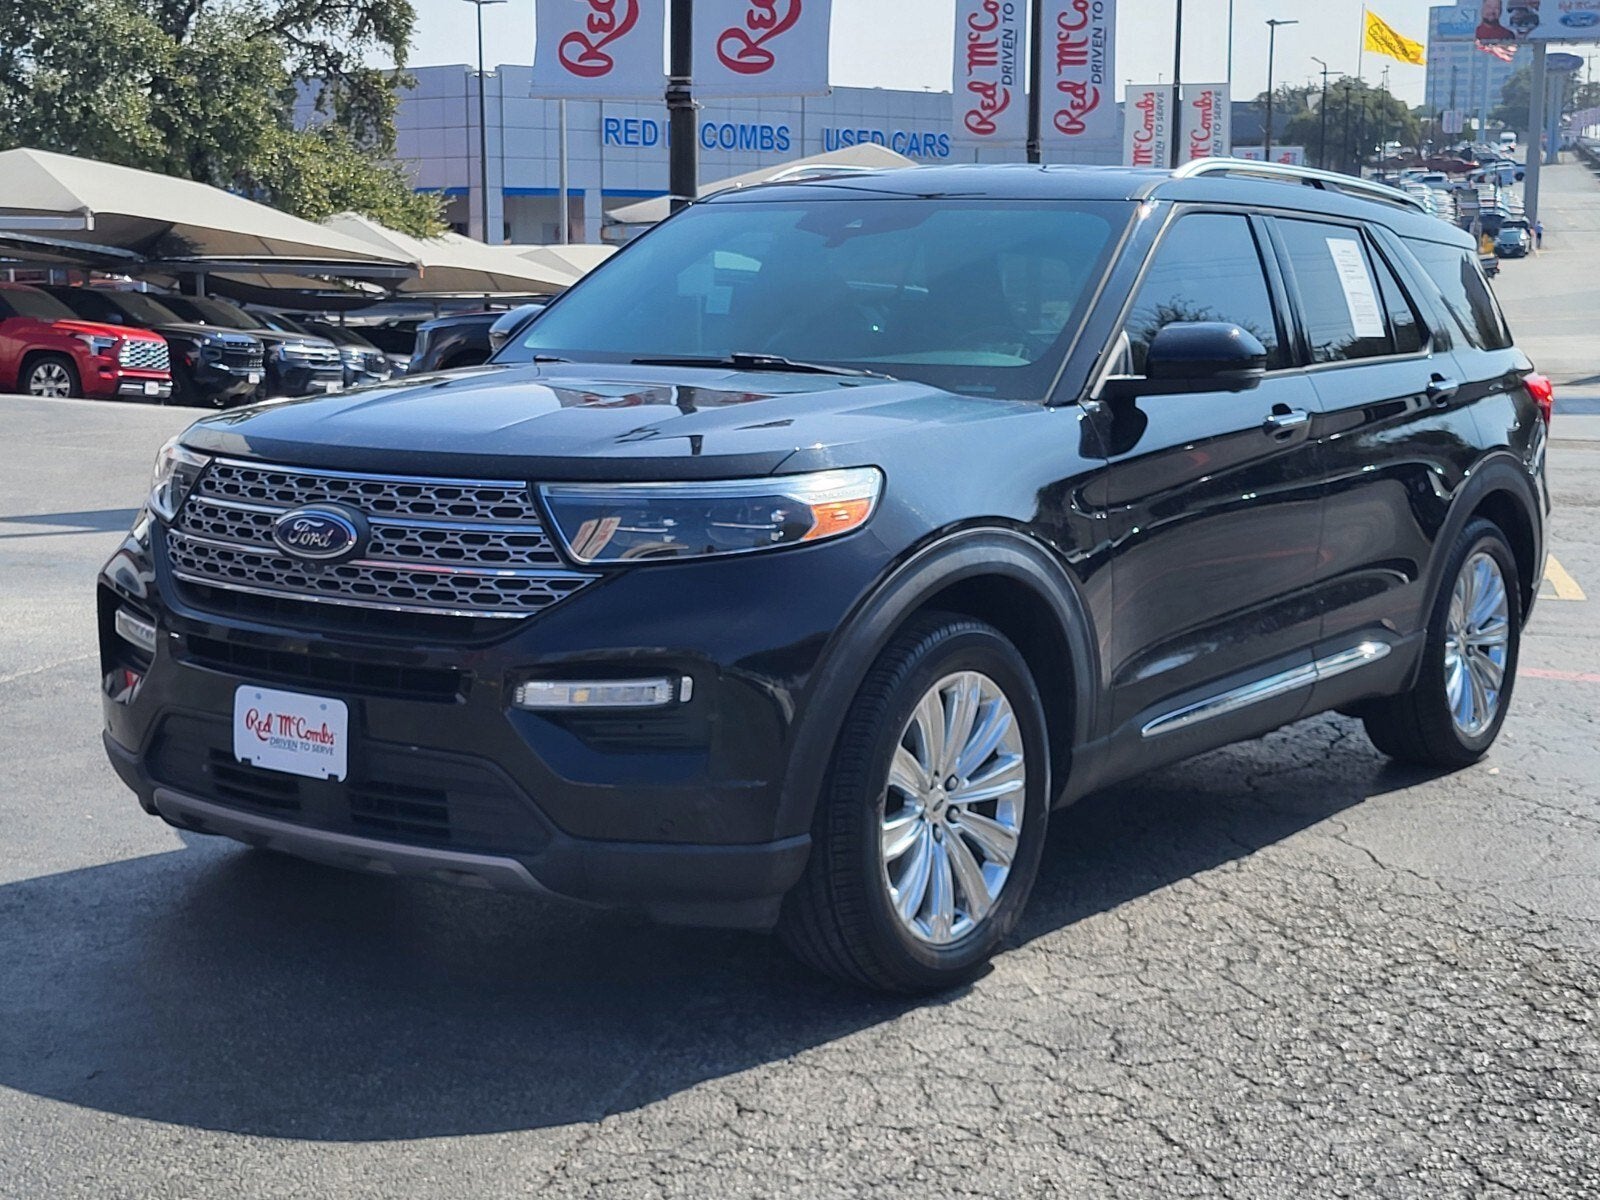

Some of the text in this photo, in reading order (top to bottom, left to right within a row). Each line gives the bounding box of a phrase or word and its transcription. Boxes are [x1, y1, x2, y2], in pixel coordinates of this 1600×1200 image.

[1001, 2, 1015, 86] DRIVEN TO
[1091, 0, 1104, 85] DRIVEN TO
[964, 0, 1011, 135] Red McCo
[1053, 0, 1100, 135] Red McCo
[1156, 91, 1165, 122] SERVE
[1213, 90, 1222, 121] SERVE
[604, 117, 791, 151] RED COMBS
[825, 128, 950, 157] USED CARS
[1132, 92, 1155, 167] McCombs
[1155, 124, 1164, 137] TO
[1213, 123, 1222, 136] TO
[288, 519, 334, 548] Ford
[246, 708, 334, 745] Red McCombs
[269, 736, 335, 756] DRIVEN TO SERVE
